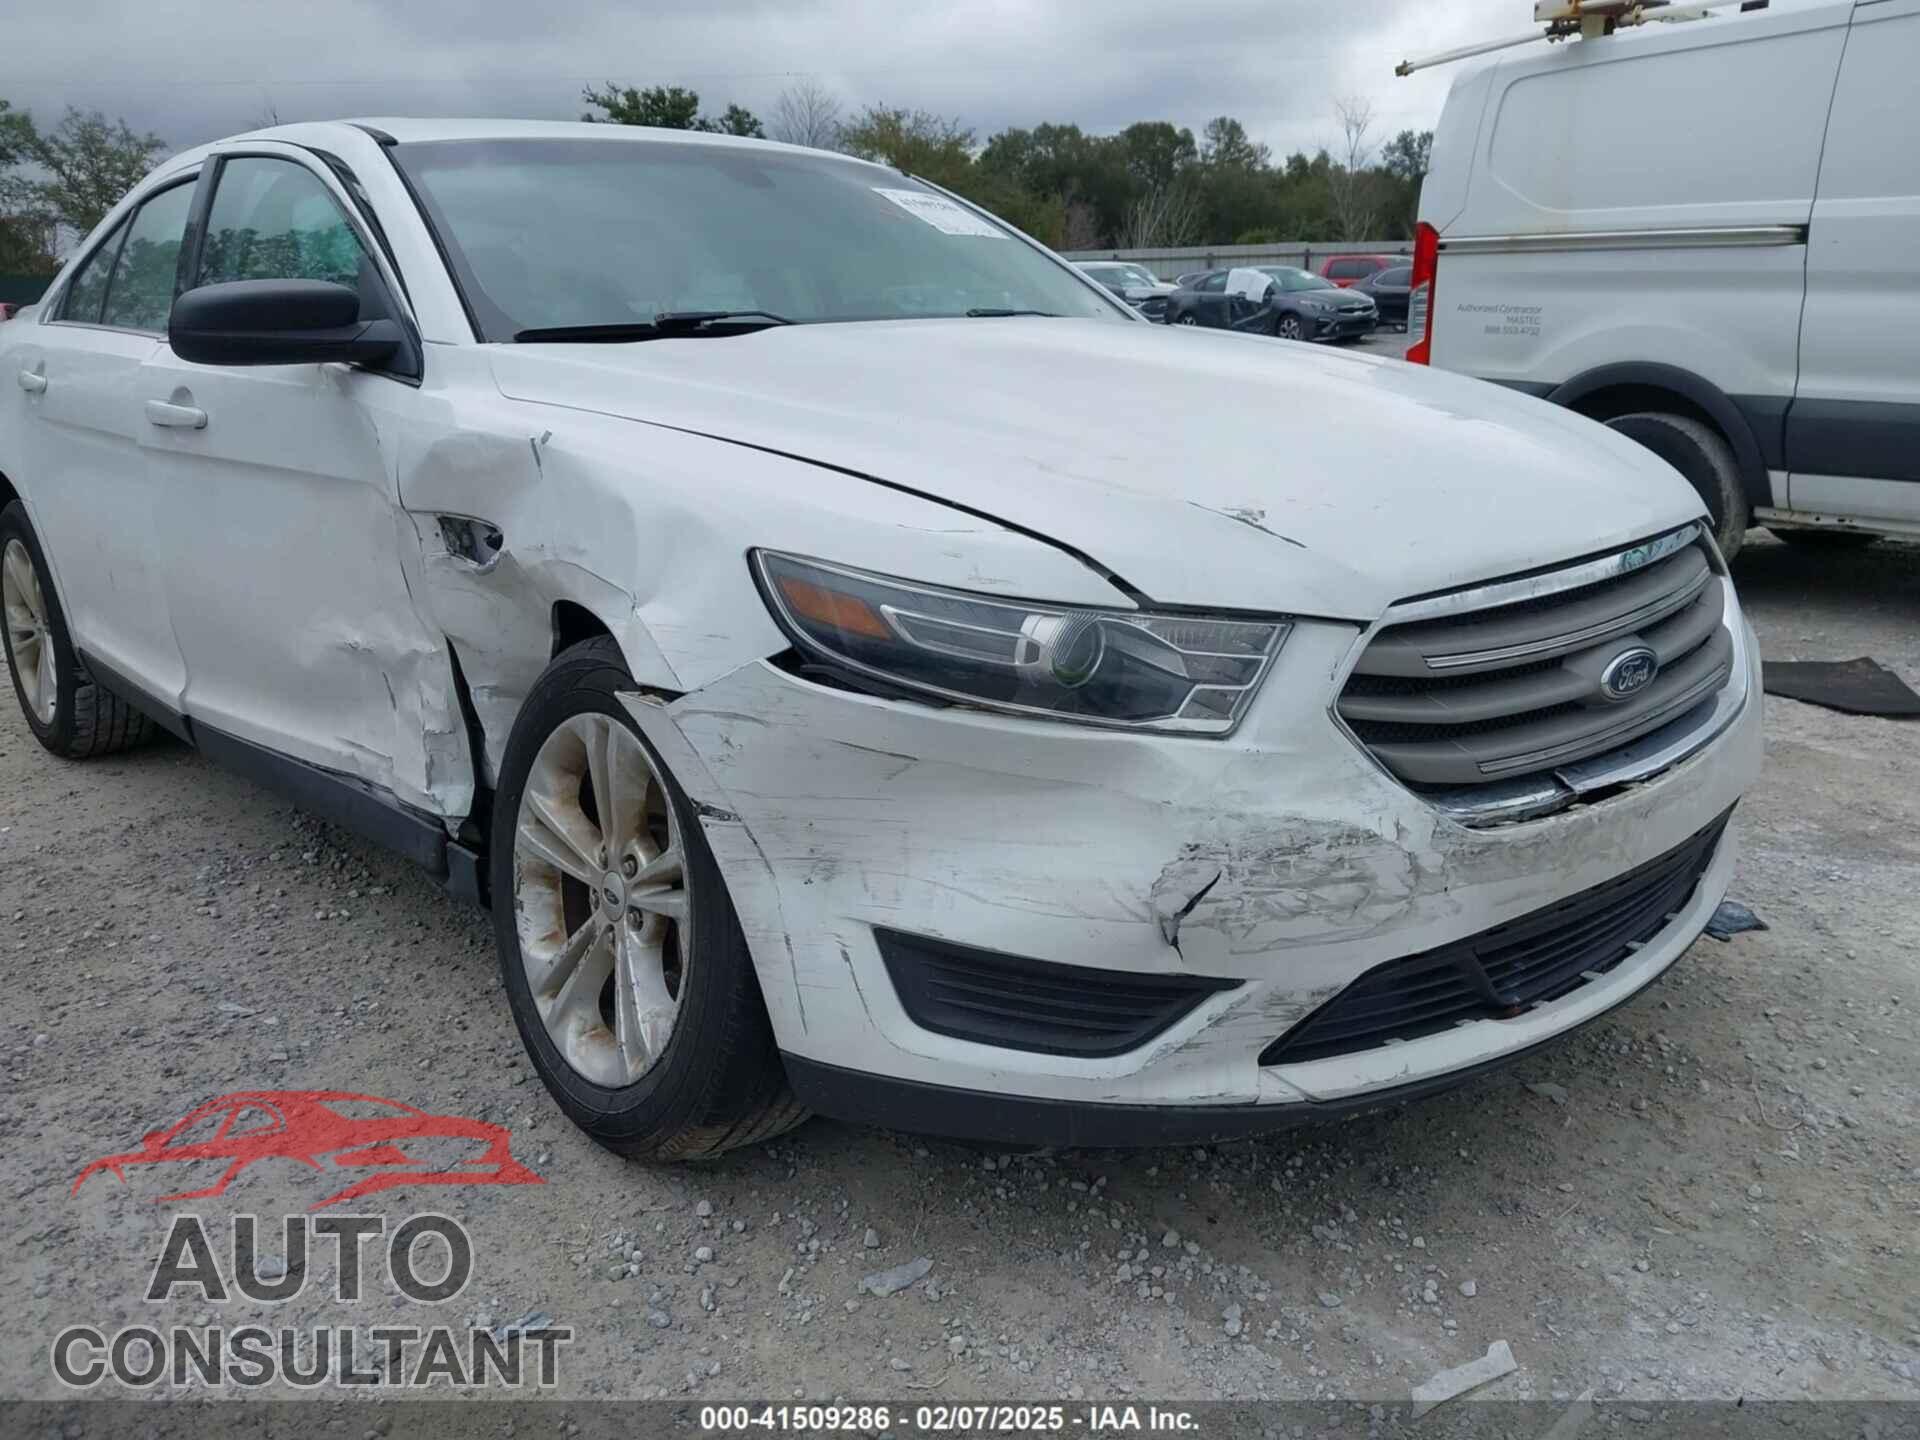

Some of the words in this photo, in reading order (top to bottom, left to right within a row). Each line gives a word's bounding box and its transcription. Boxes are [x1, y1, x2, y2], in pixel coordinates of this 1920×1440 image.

[1457, 303, 1498, 313] Authorized
[1499, 303, 1543, 314] Contractor
[1506, 315, 1541, 325] MASTEC
[1618, 658, 1649, 691] Ford
